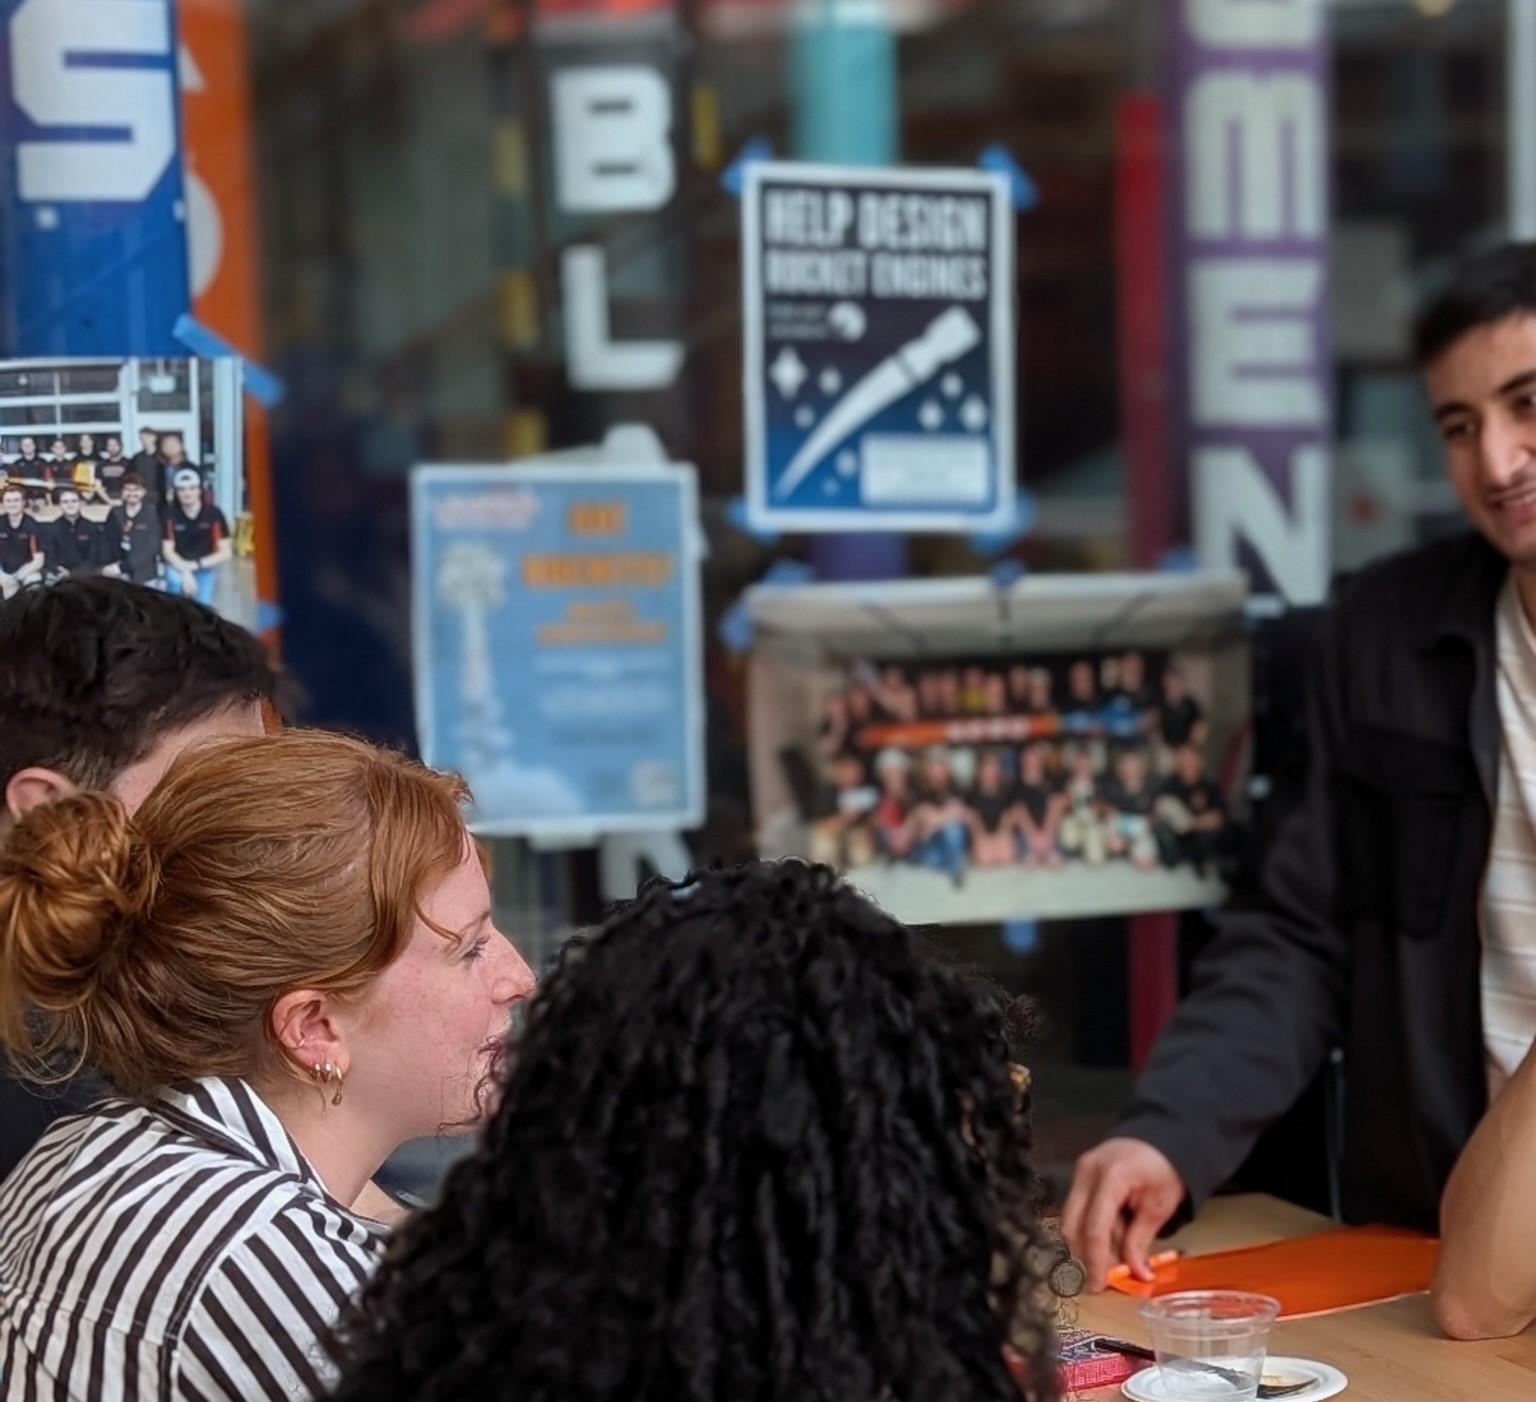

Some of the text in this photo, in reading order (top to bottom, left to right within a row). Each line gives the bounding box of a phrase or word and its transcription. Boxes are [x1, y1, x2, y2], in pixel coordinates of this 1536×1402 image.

[764, 188, 987, 252] HELP DESIGN
[765, 250, 987, 300] ROCKET ENGINES
[1185, 0, 1335, 605] MEN
